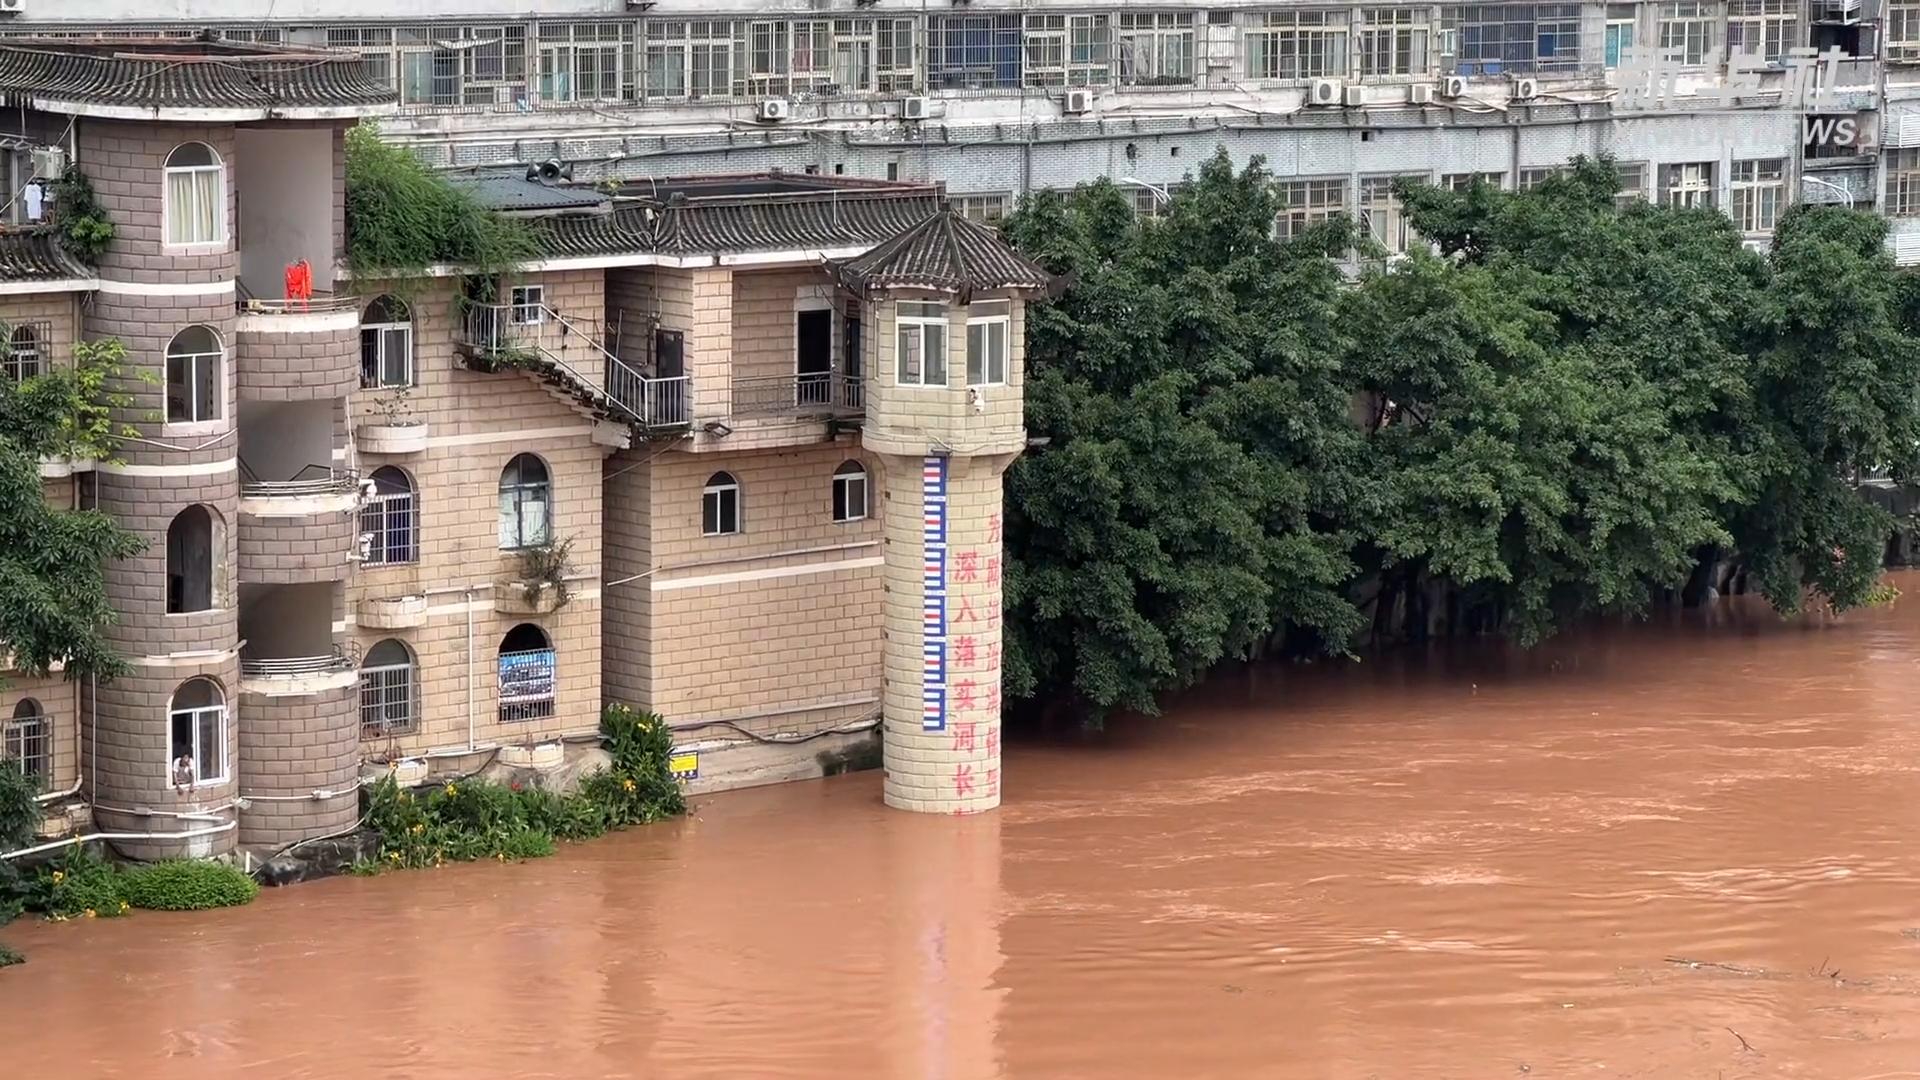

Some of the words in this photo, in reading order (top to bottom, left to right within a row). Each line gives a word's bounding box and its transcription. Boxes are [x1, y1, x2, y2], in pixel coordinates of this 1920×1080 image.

[953, 552, 978, 815] 深入落实河长
